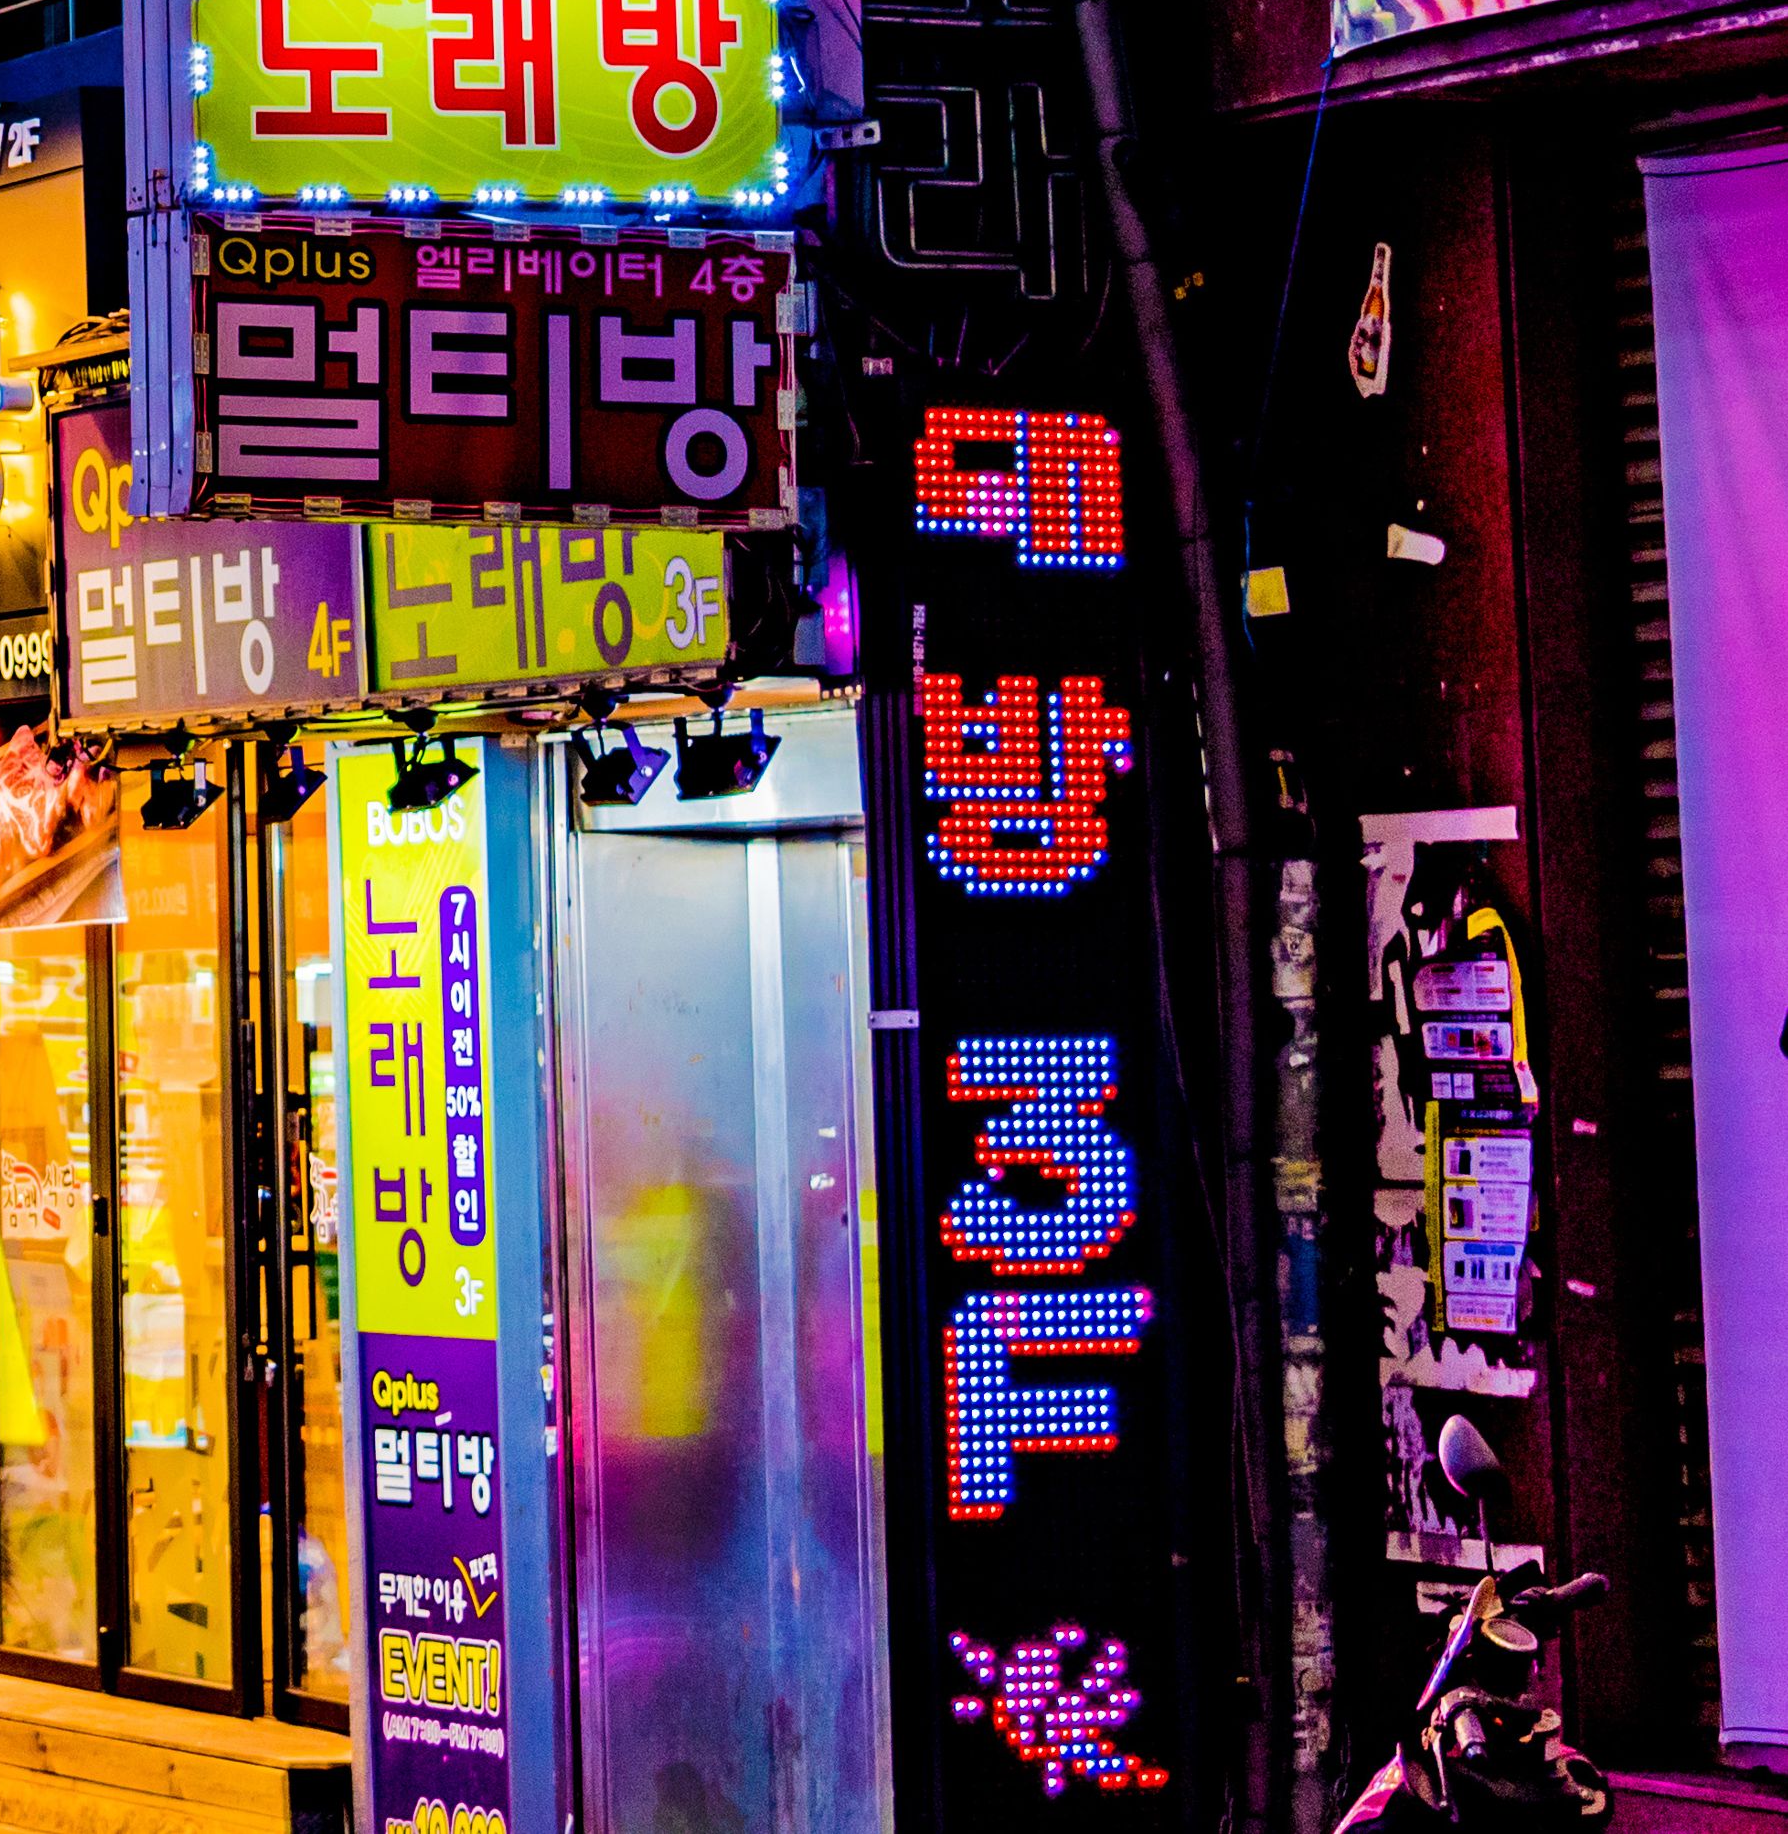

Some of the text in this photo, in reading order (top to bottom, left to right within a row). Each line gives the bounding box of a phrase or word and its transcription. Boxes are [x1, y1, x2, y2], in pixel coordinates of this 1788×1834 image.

[216, 236, 766, 304] Qplus 엘리베이터 4층
[214, 298, 773, 502] 멀티방
[77, 544, 353, 704] 멀티방 4F
[385, 526, 721, 682] 노래방 3F
[364, 877, 434, 1288] 노래방
[445, 892, 482, 1232] 7시이전 50% 할인
[454, 1266, 486, 1317] 3F
[371, 1369, 440, 1417] Qplus
[374, 1428, 495, 1515] 멀티방
[433, 1579, 468, 1623] 이용
[379, 1627, 501, 1716] EVENT!
